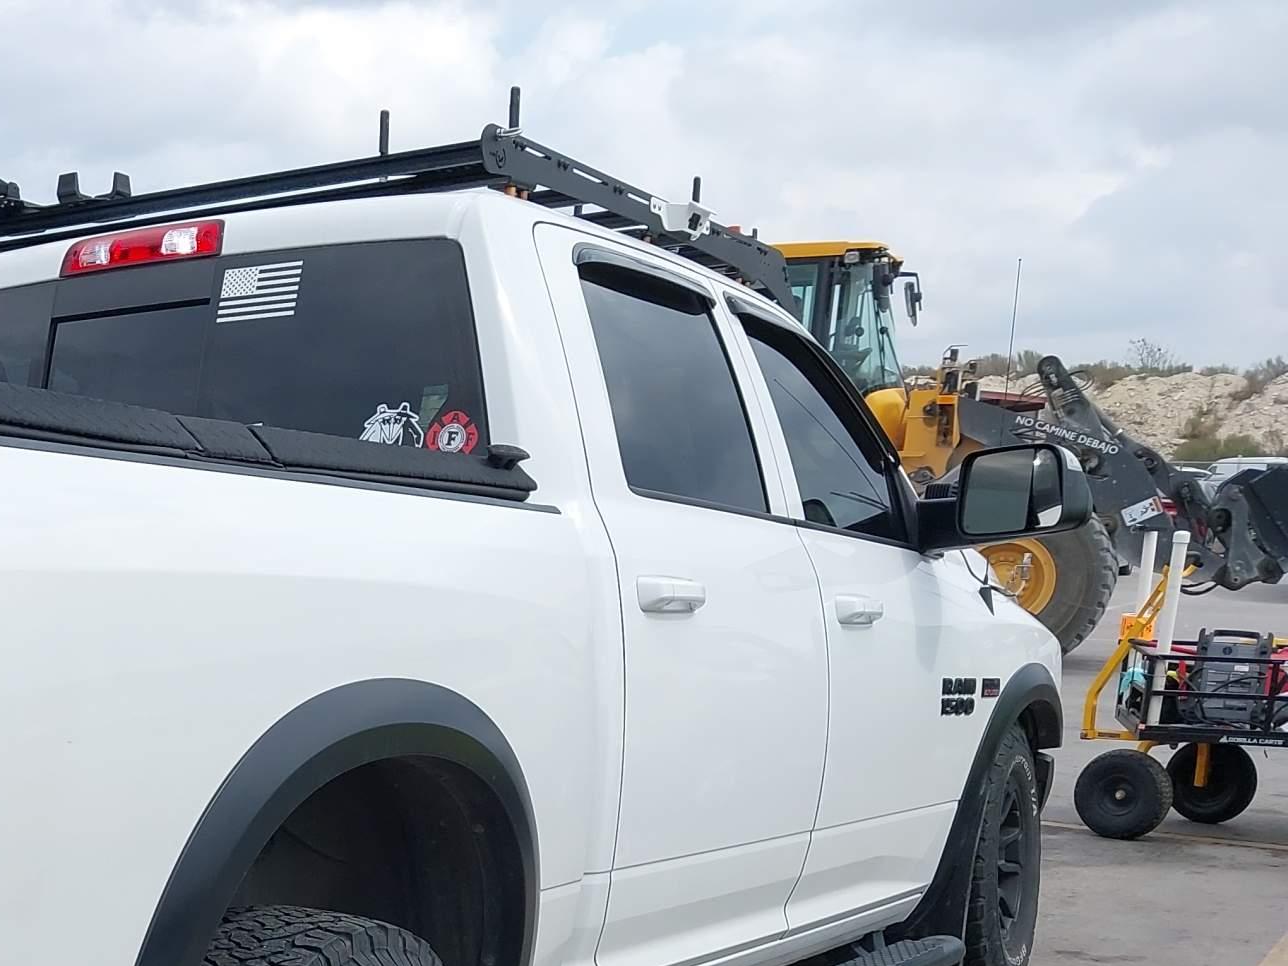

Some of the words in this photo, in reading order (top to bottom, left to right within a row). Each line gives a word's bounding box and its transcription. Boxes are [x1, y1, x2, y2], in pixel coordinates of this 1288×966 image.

[1015, 416, 1034, 427] NO
[1035, 421, 1077, 441] CAMINE
[1077, 434, 1119, 454] DEBAJO
